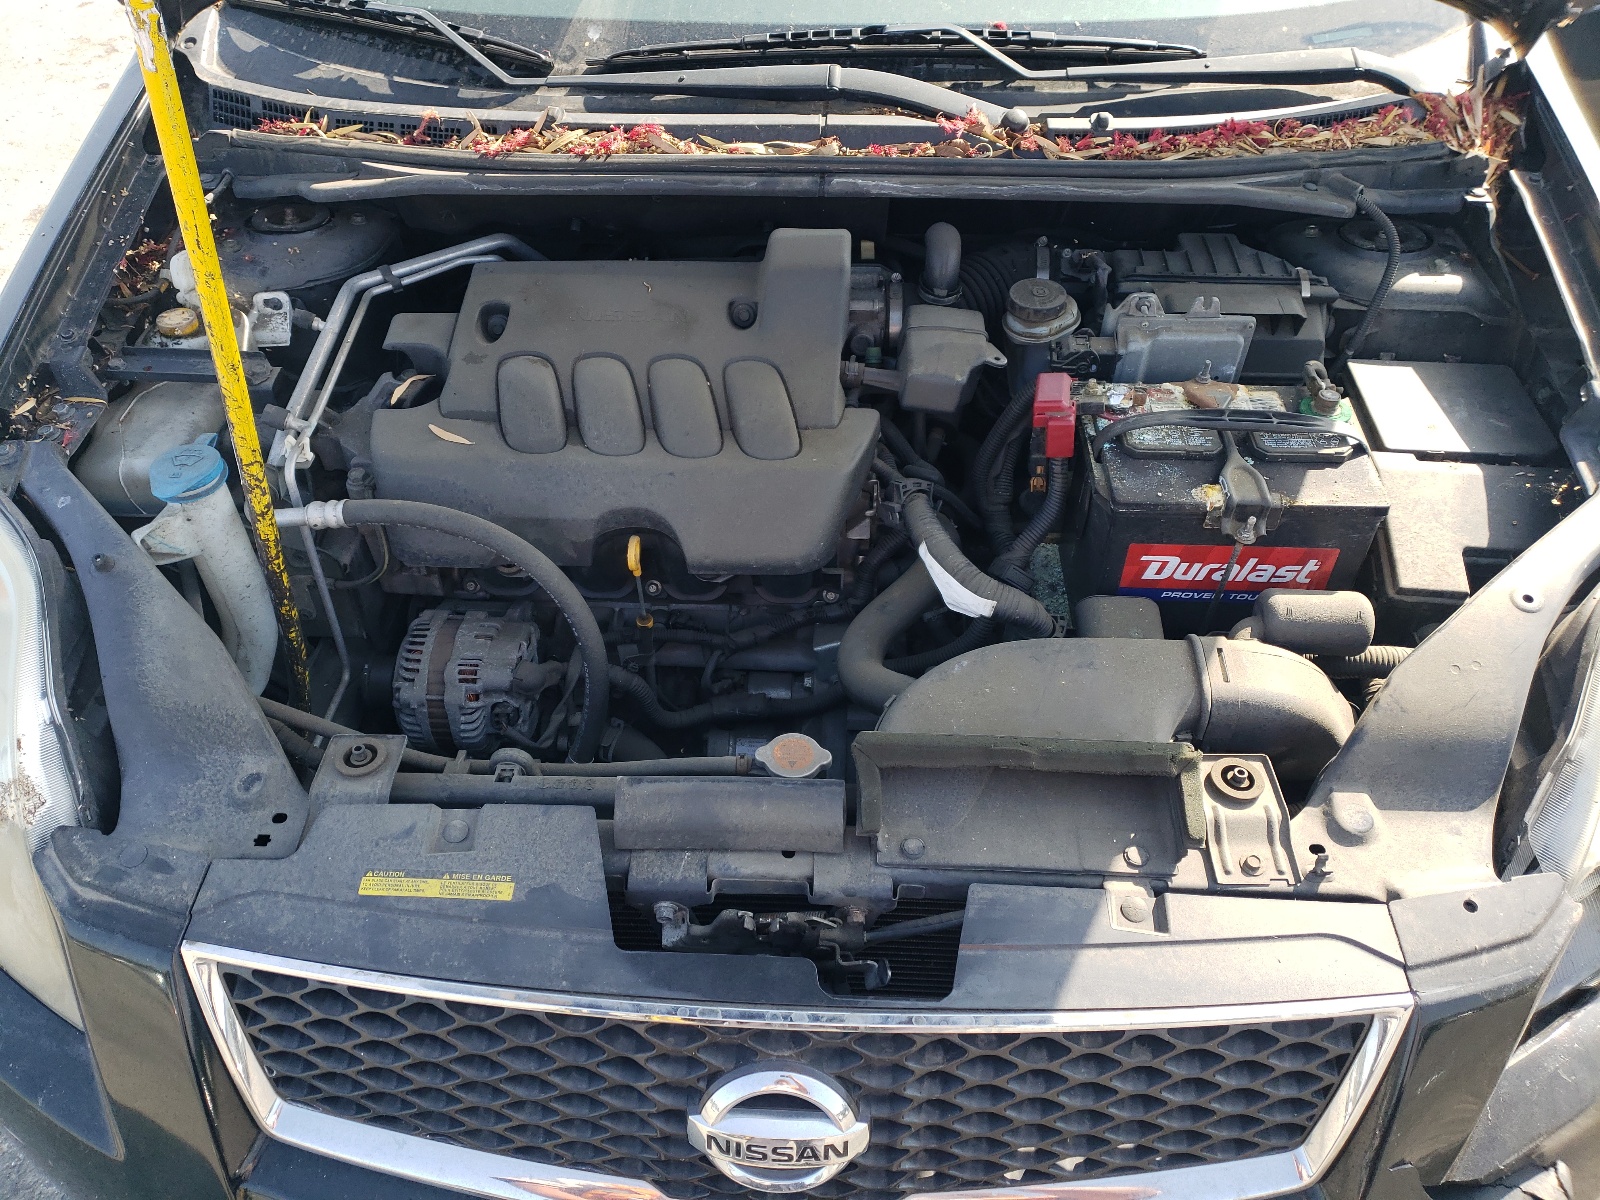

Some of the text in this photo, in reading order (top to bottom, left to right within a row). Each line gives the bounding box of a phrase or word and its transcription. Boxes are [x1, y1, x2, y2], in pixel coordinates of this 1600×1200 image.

[1140, 555, 1321, 584] Duralast
[1229, 593, 1259, 601] TOU
[706, 1133, 849, 1163] NISSAN
